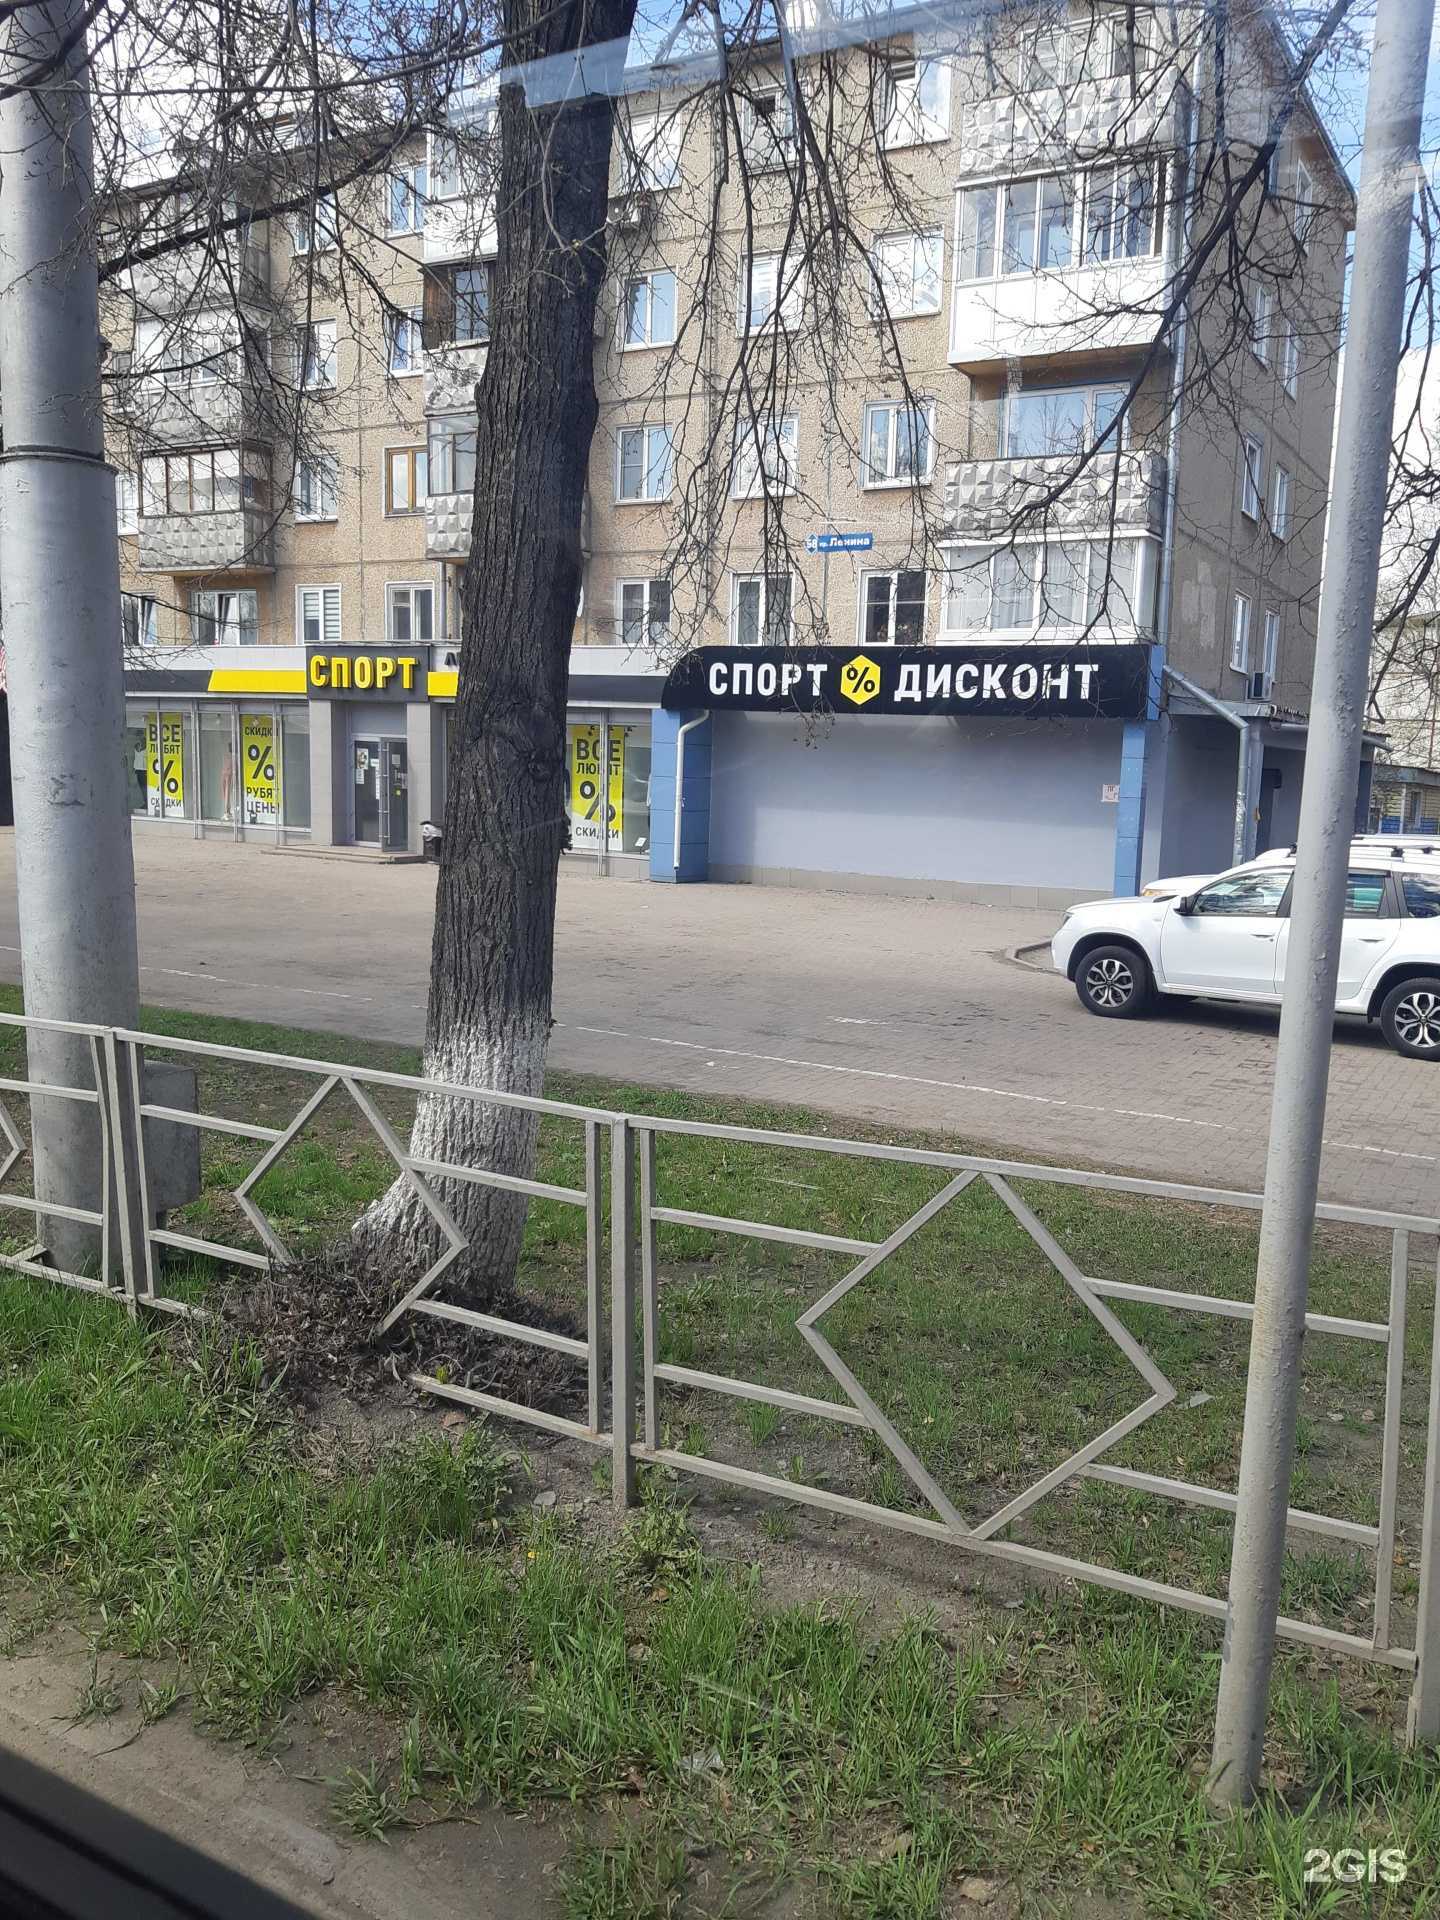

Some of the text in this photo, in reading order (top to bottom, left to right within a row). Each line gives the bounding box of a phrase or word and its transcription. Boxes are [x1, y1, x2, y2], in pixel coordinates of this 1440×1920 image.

[830, 537, 870, 546] Ленина
[310, 655, 416, 689] СПОРТ
[709, 662, 828, 697] СПОРТ
[893, 663, 1099, 702] ДИСКОНТ
[150, 797, 182, 809] СКДКИ
